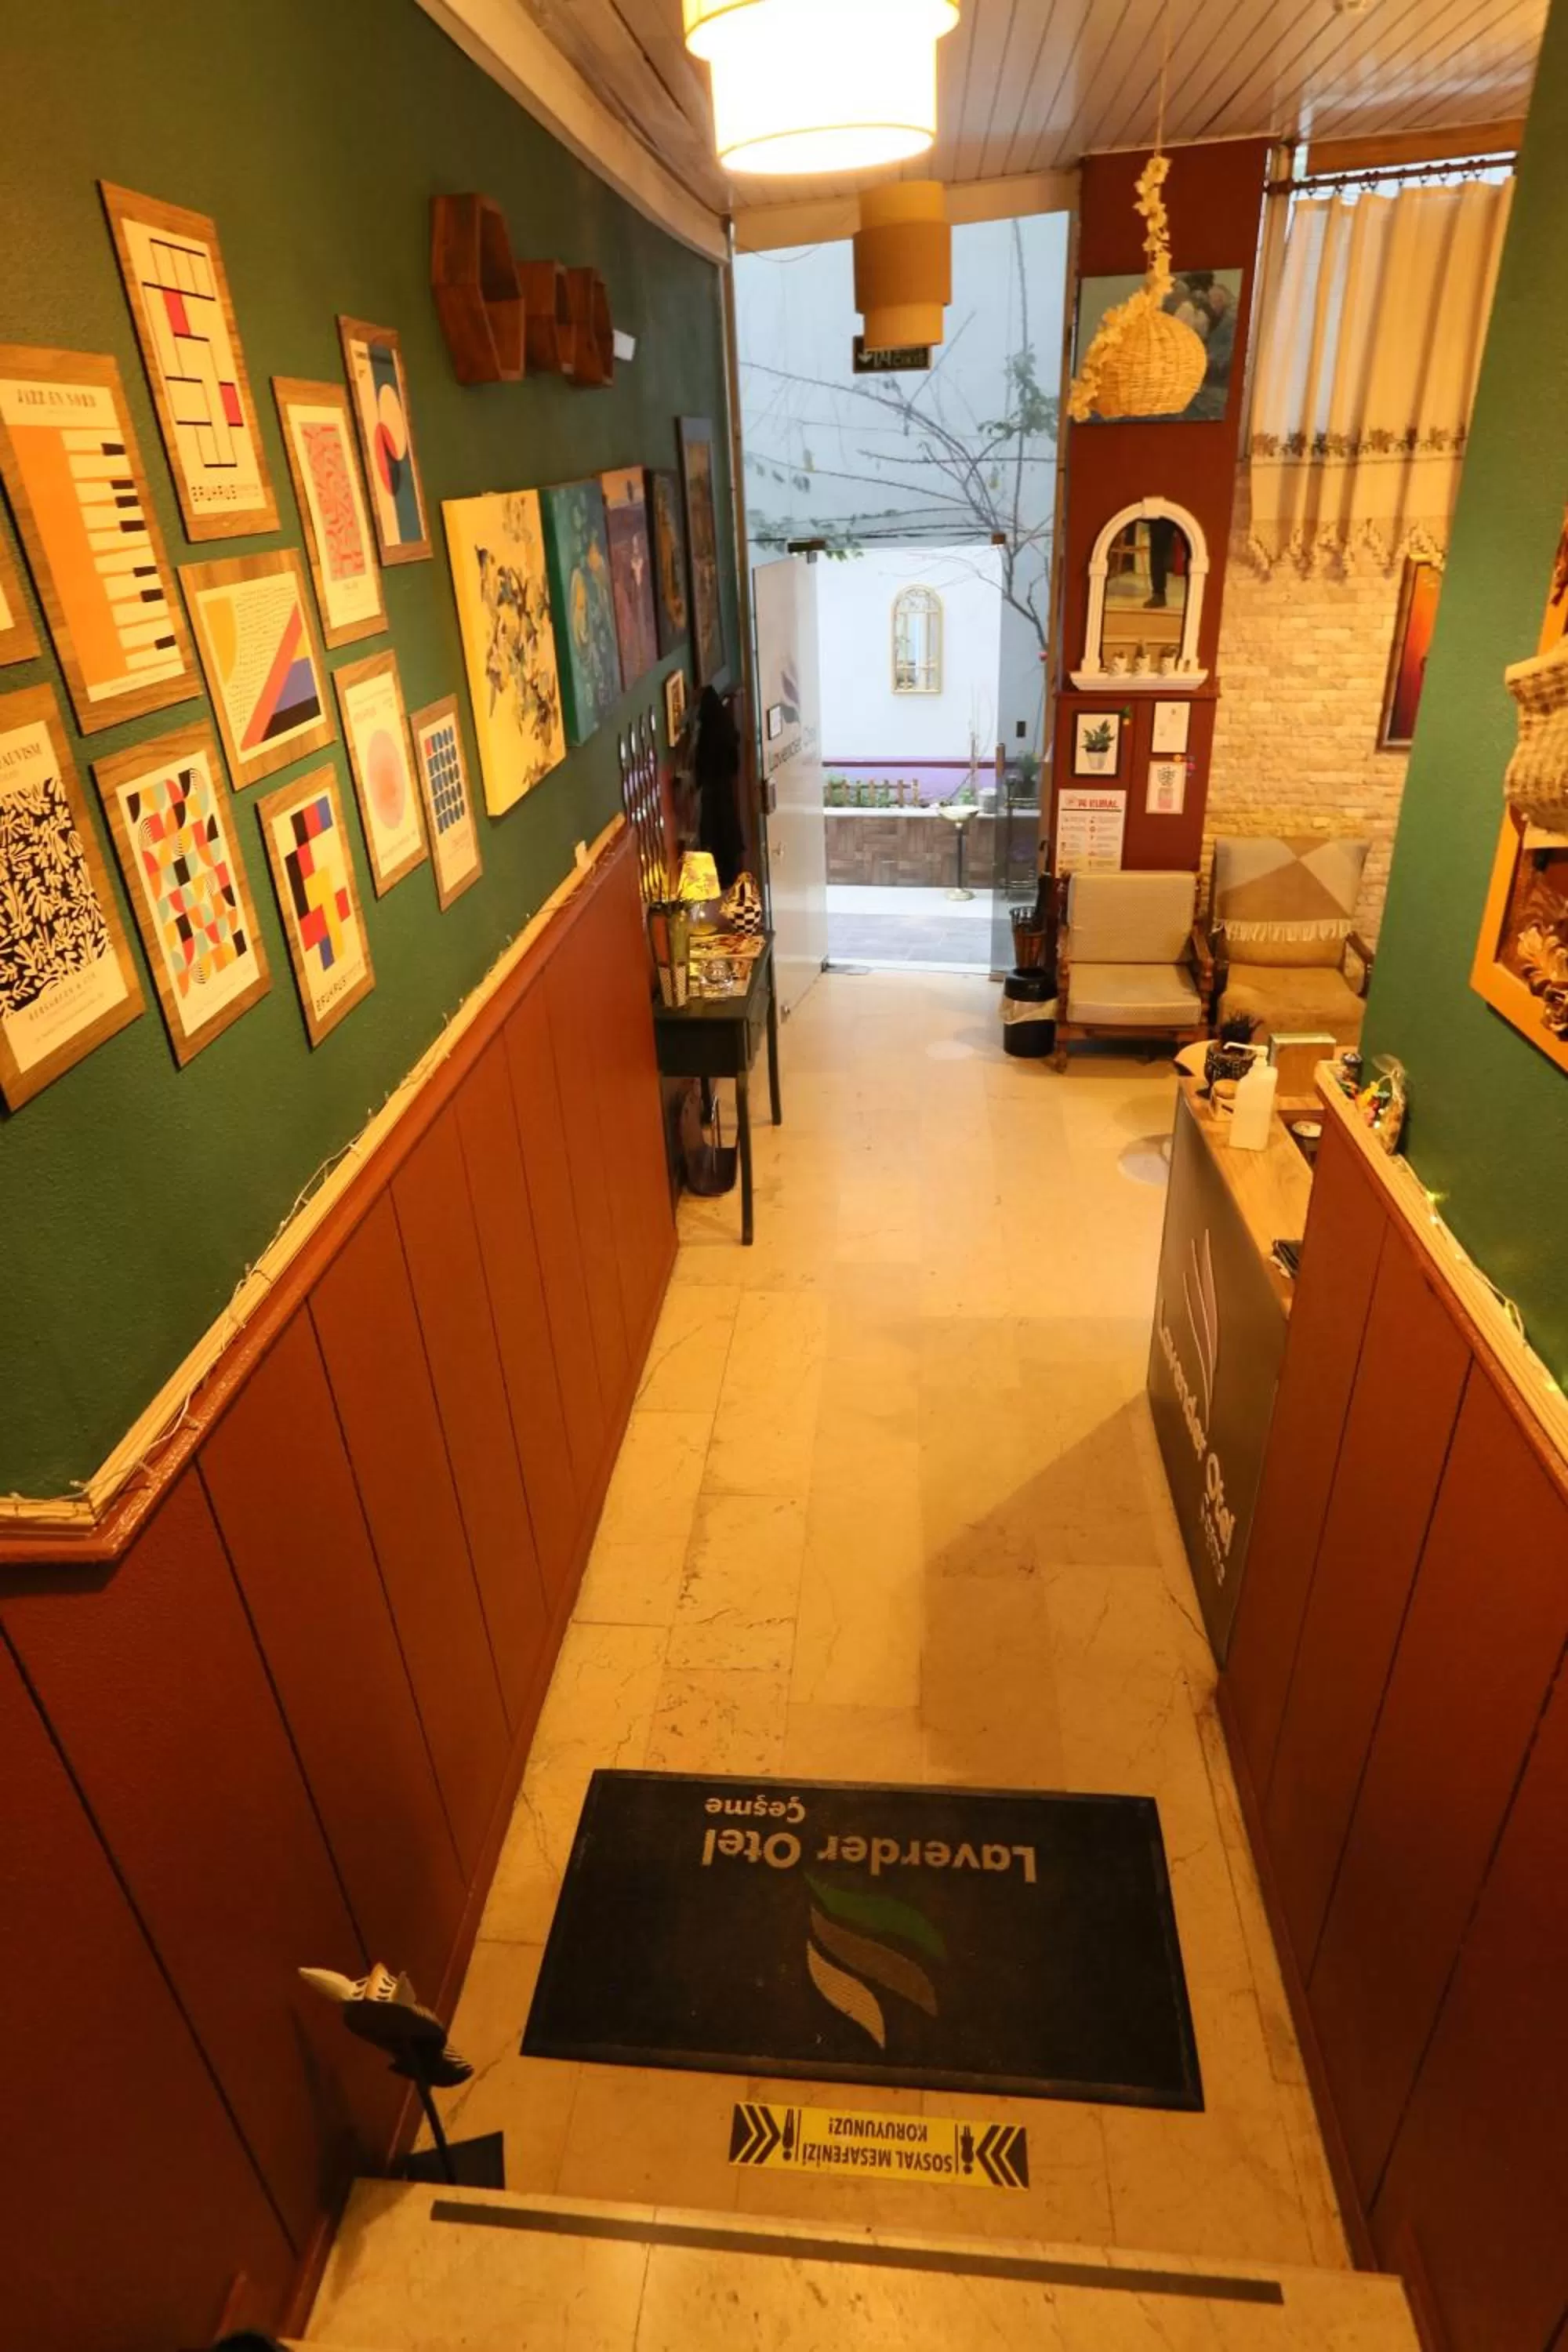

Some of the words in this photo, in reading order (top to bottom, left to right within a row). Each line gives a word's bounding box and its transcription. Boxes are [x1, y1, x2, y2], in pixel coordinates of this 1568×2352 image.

[705, 1794, 806, 1824] Çeşme
[701, 1828, 801, 1869] Otel
[828, 2117, 927, 2142] KORUYUNUZ!
[802, 2143, 891, 2169] MESAFENİZİ
[895, 2151, 953, 2172] SOSYAL
